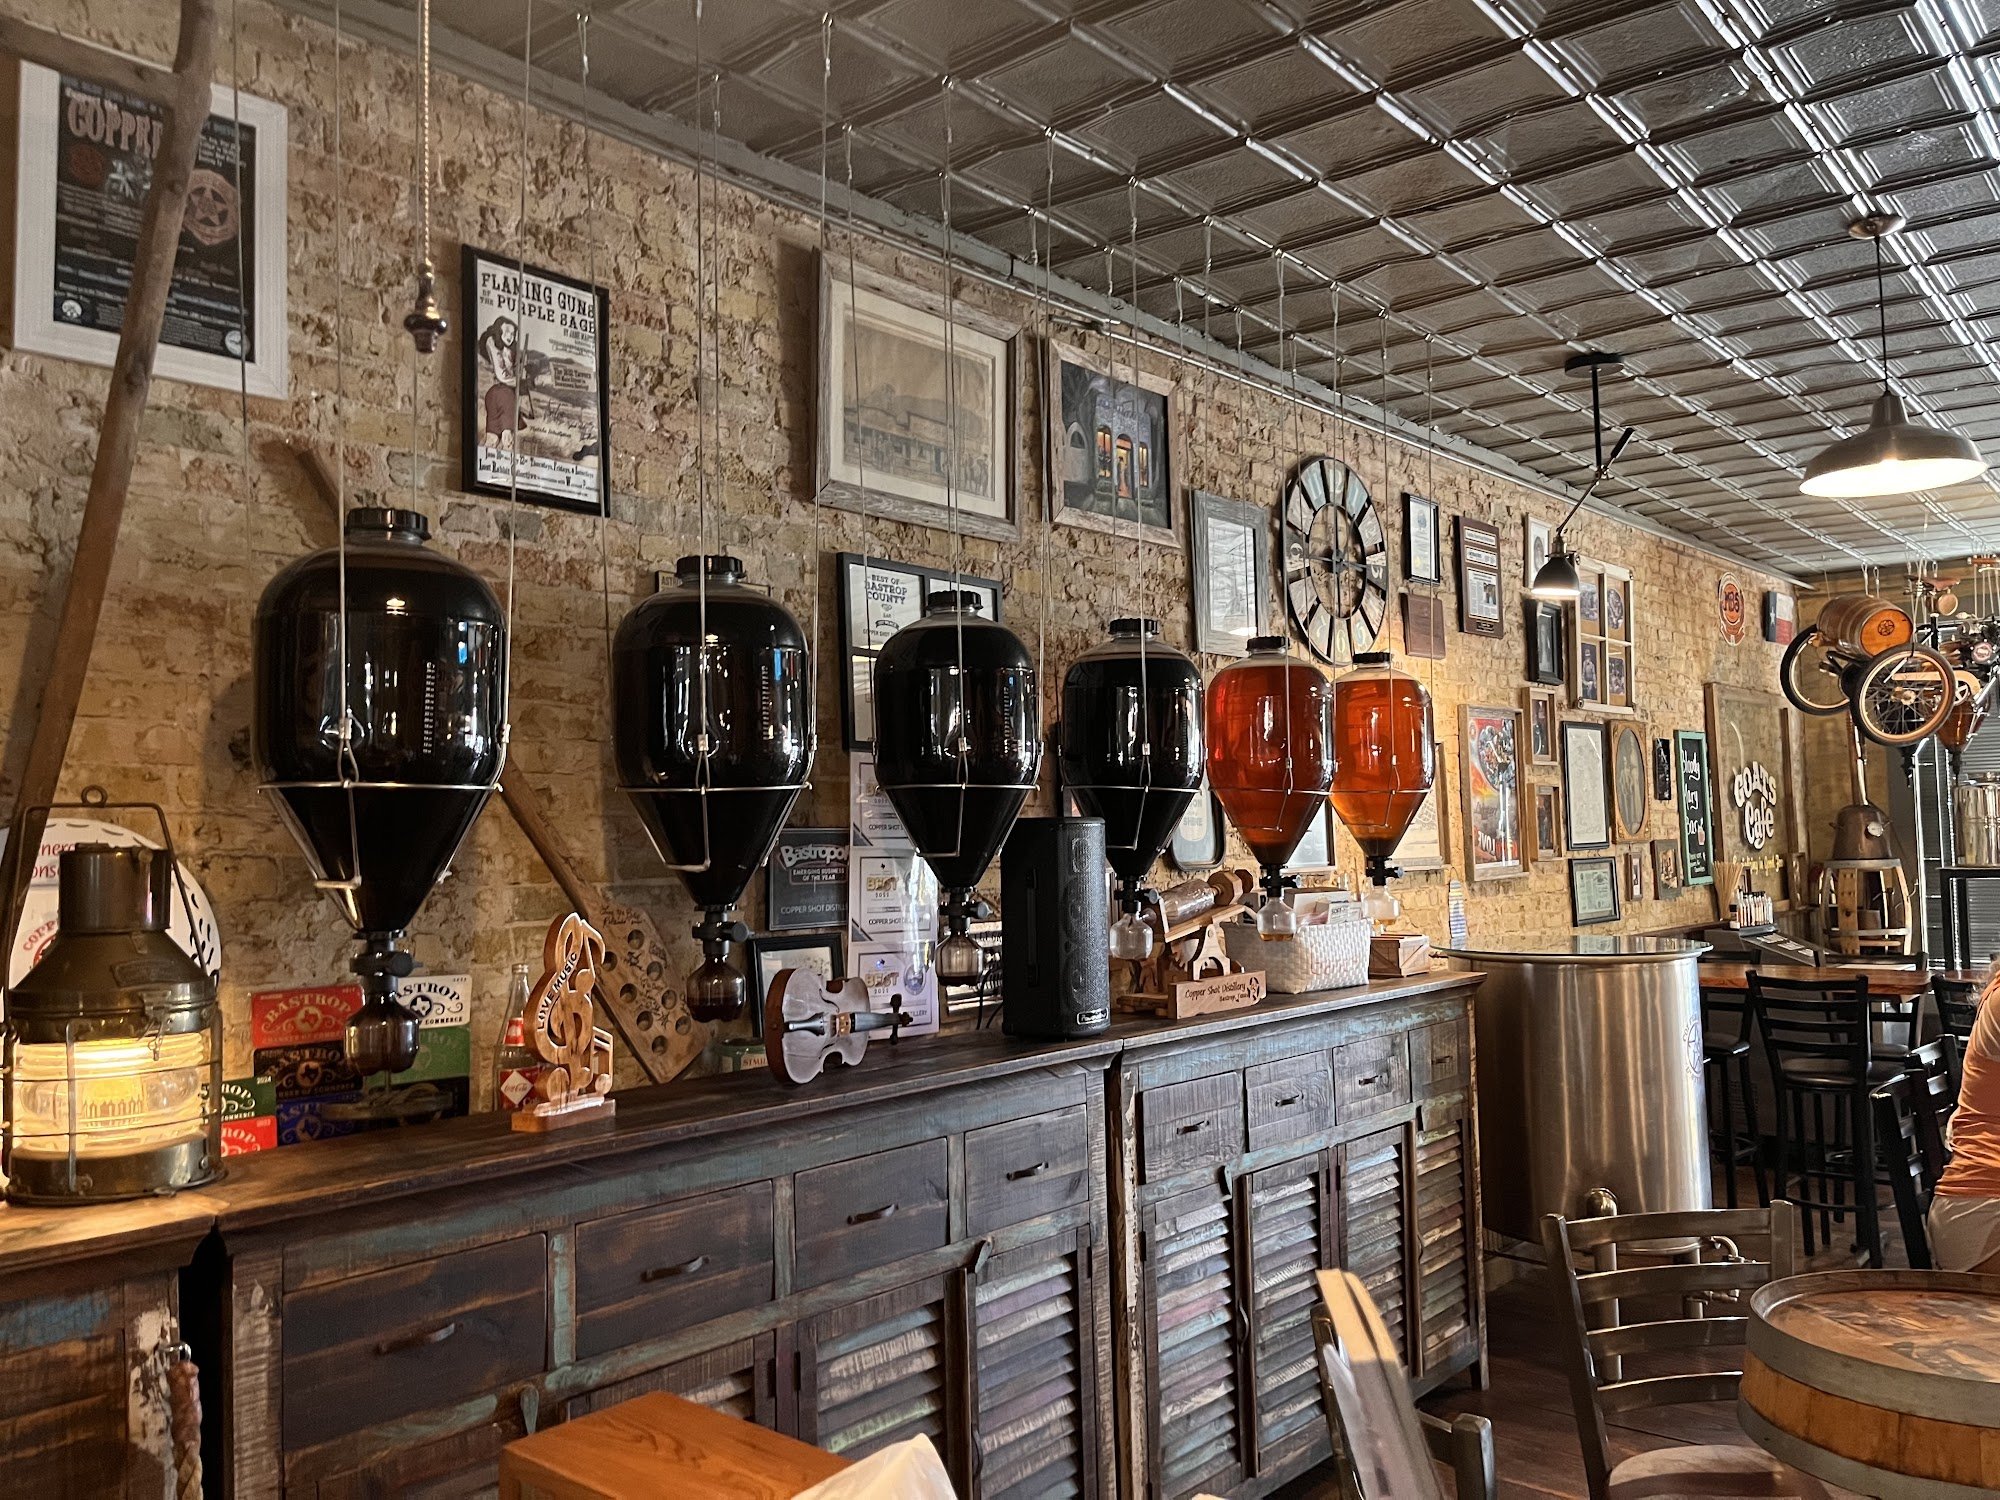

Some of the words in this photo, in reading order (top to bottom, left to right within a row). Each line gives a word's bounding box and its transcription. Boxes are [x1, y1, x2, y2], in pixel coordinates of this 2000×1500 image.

[864, 580, 908, 596] BASTROP
[872, 574, 889, 583] BEST
[867, 591, 906, 605] COUNTY
[1734, 761, 1777, 807] GOATS
[1744, 796, 1775, 849] Cafe
[780, 905, 807, 915] COPPER
[808, 904, 824, 912] SHOT
[825, 903, 847, 912] DISTILL
[23, 920, 57, 952] COPP
[400, 982, 461, 1002] STROP
[537, 991, 555, 1031] LOVE
[552, 951, 578, 992] MUSIC
[1185, 987, 1206, 1001] Copper
[1207, 984, 1220, 996] Shot
[1221, 980, 1246, 992] Distillery
[266, 993, 353, 1024] BASTROP
